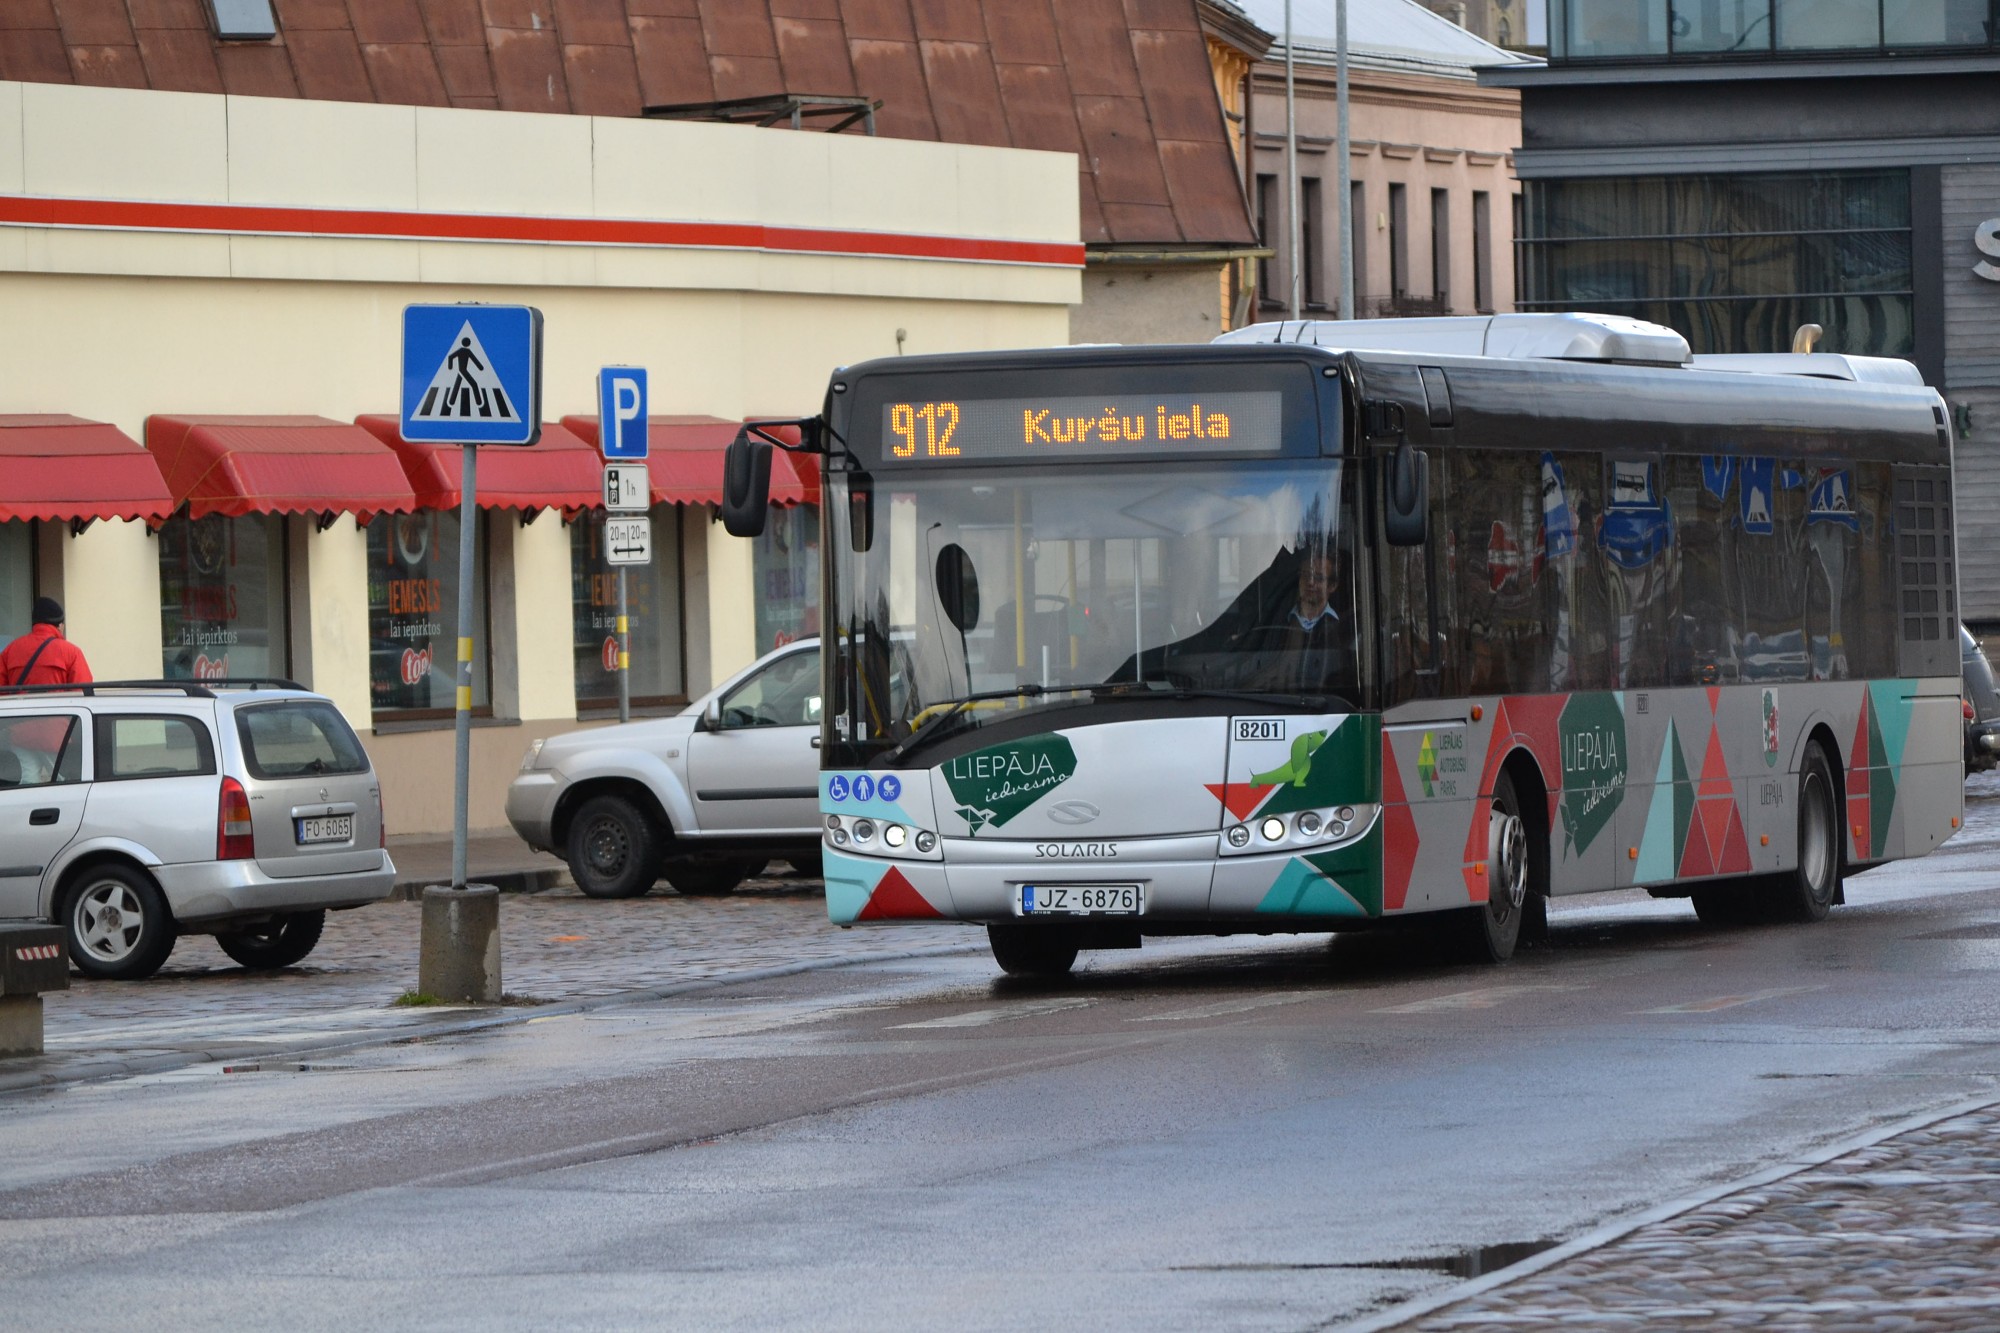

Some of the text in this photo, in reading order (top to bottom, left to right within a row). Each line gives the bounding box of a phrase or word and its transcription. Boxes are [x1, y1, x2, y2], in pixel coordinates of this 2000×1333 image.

[613, 378, 641, 448] P
[891, 402, 1229, 456] 912 Kuršu iela
[389, 579, 440, 614] IEMESLS
[183, 626, 238, 650] lai iepirktos
[390, 618, 440, 641] lai iepirktos
[1240, 722, 1278, 738] 8201
[1565, 725, 1618, 771] LIEPĀJA
[953, 752, 1055, 779] LIEPĀJA
[985, 772, 1071, 803] iedvesmo
[305, 818, 349, 838] FO-6065
[1035, 843, 1117, 858] SOLARIS
[1039, 889, 1133, 909] JZ-6876
